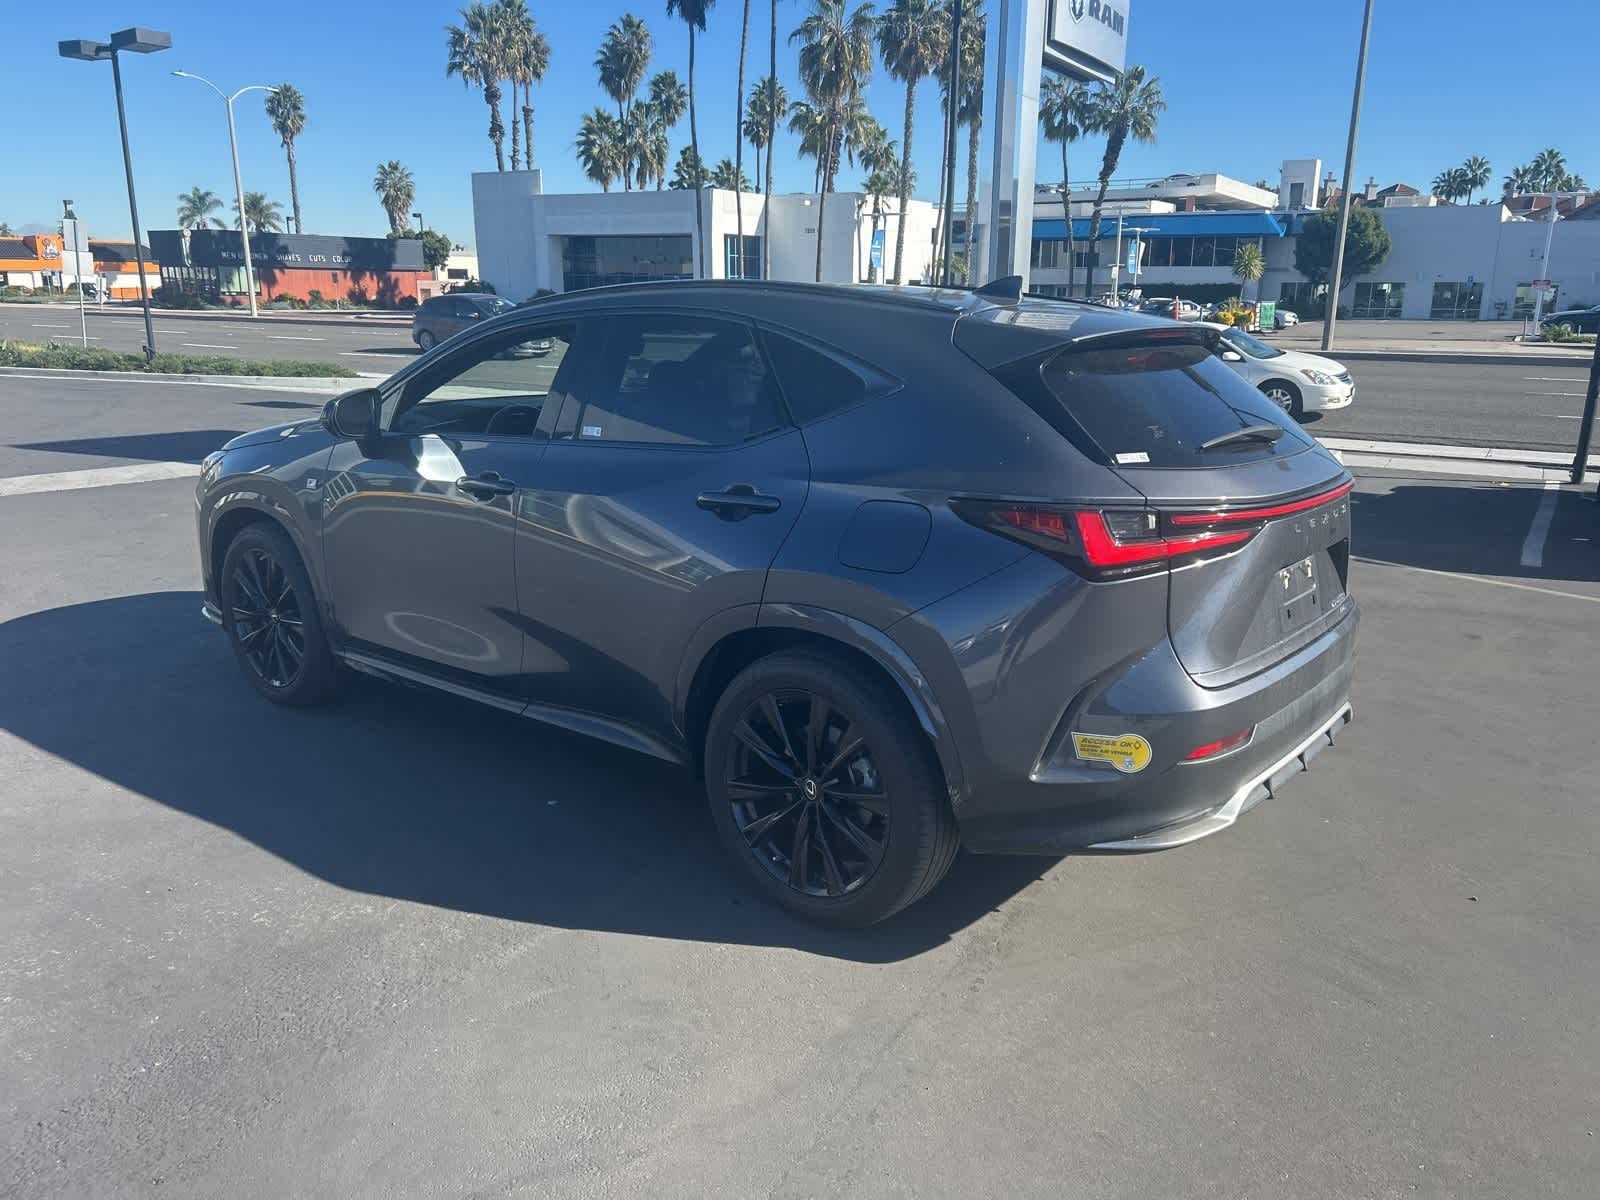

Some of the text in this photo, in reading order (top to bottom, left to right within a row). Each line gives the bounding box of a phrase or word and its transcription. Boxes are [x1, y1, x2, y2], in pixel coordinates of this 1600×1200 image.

[1088, 0, 1124, 37] RAM
[278, 254, 301, 262] SHAVES
[1295, 504, 1347, 533] LEXUS
